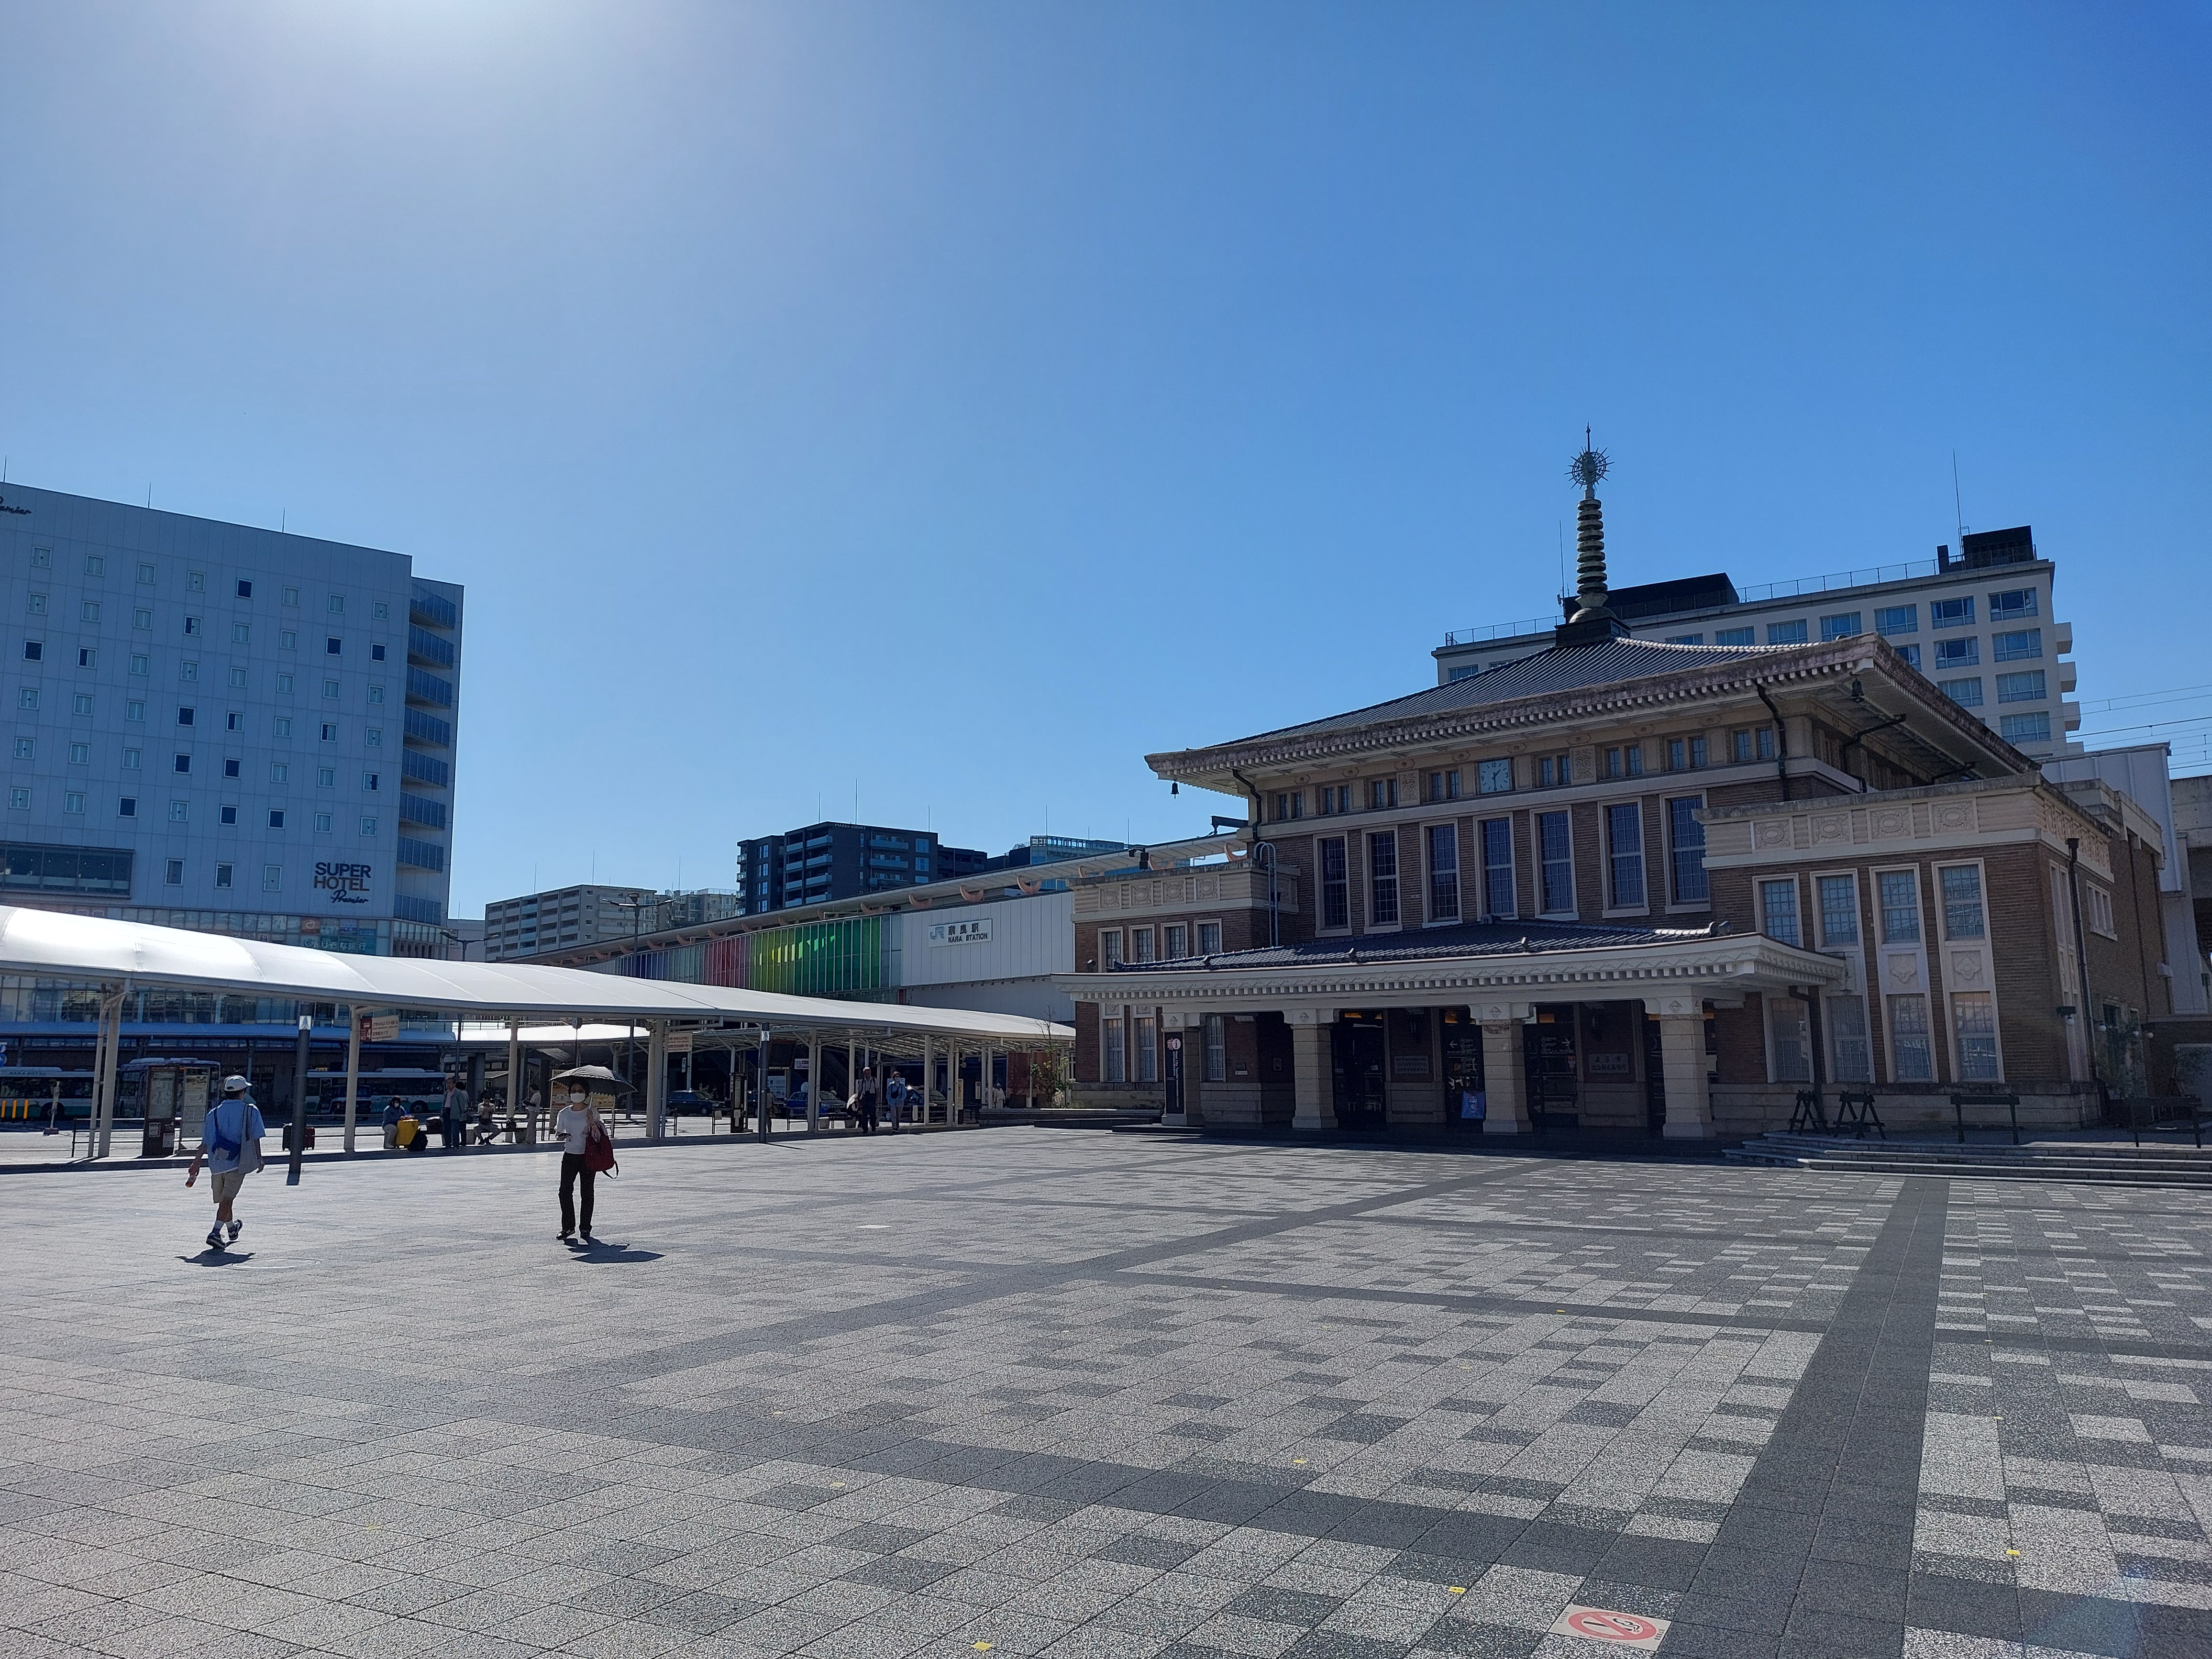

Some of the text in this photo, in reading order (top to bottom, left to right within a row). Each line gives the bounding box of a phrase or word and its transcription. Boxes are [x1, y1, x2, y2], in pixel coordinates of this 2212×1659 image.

[315, 862, 371, 878] SUPER
[314, 875, 369, 891] HOTEL
[331, 889, 369, 904] Premier
[930, 927, 945, 940] JR
[321, 941, 366, 951] りそな銀行
[366, 1029, 371, 1040] 4
